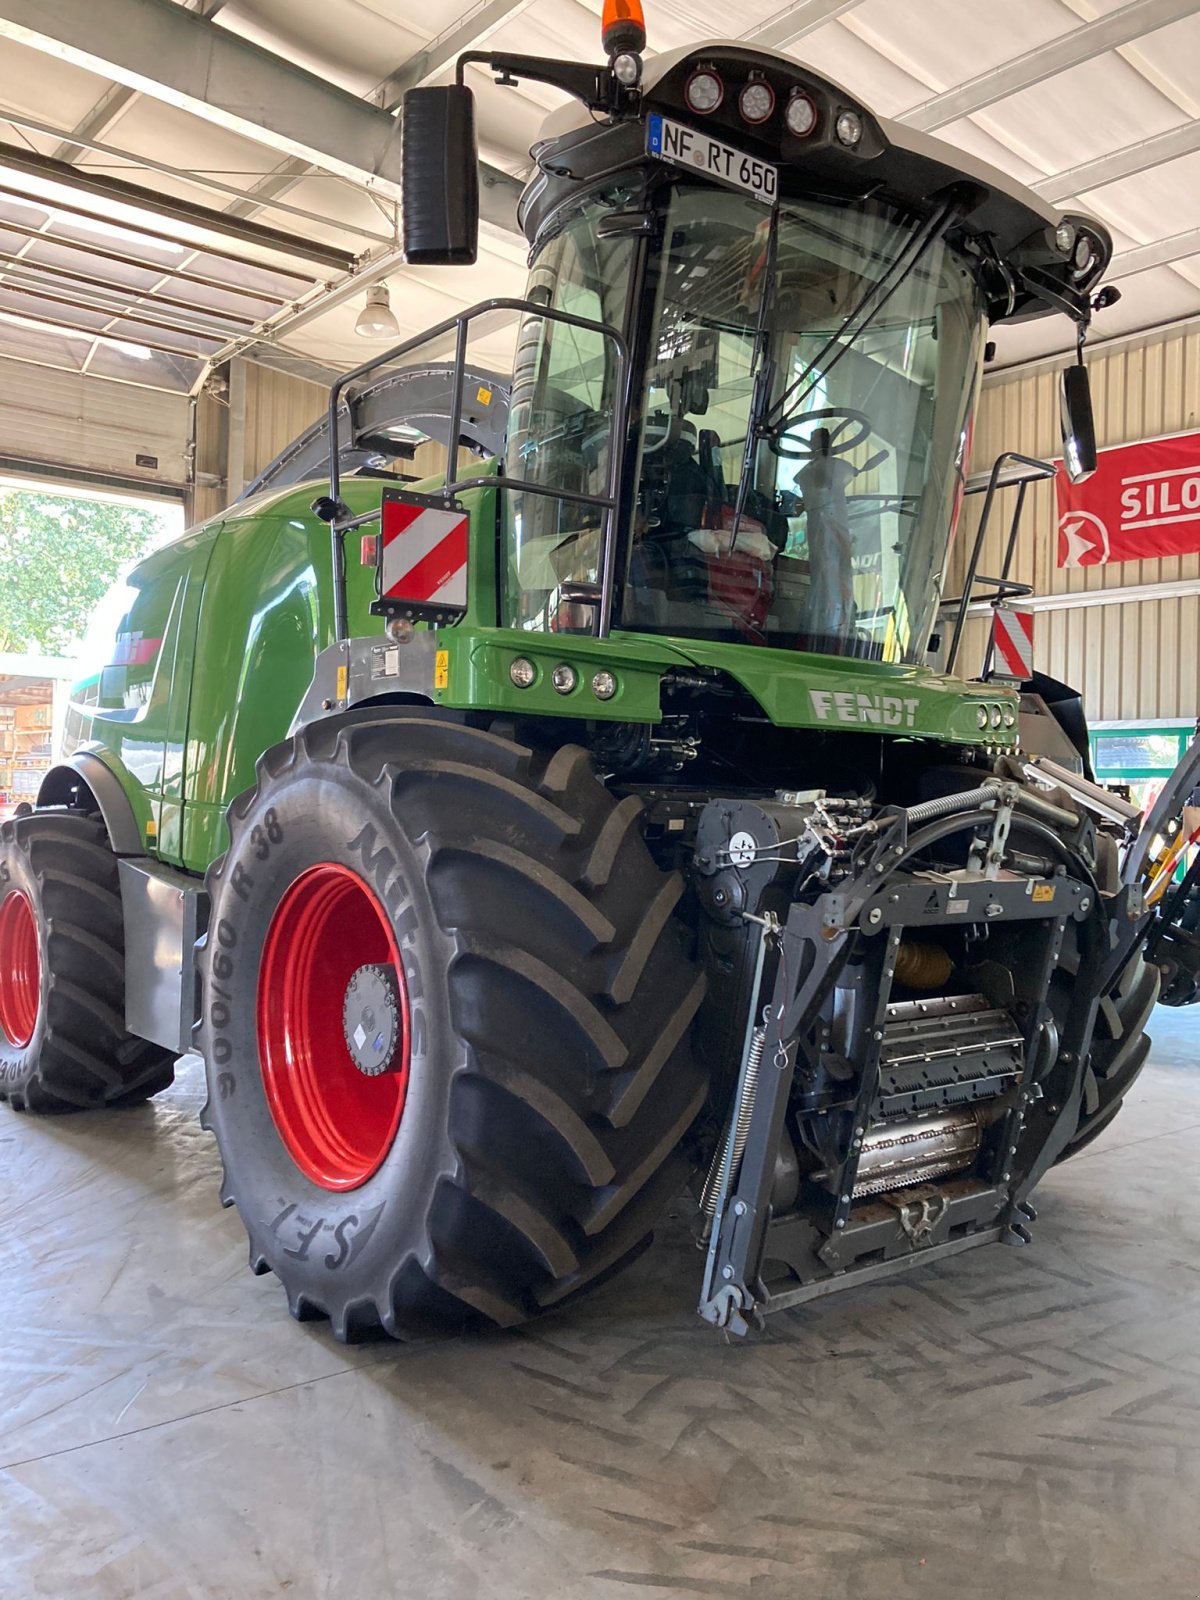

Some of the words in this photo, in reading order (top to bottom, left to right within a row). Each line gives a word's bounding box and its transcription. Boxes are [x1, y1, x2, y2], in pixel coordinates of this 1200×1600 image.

[664, 123, 694, 157] NF
[708, 142, 735, 176] RT
[740, 158, 775, 195] 650
[1121, 477, 1200, 519] SILO
[809, 689, 920, 727] FENDT
[211, 918, 237, 1099] 900/60
[230, 861, 253, 899] R
[251, 806, 283, 860] 38
